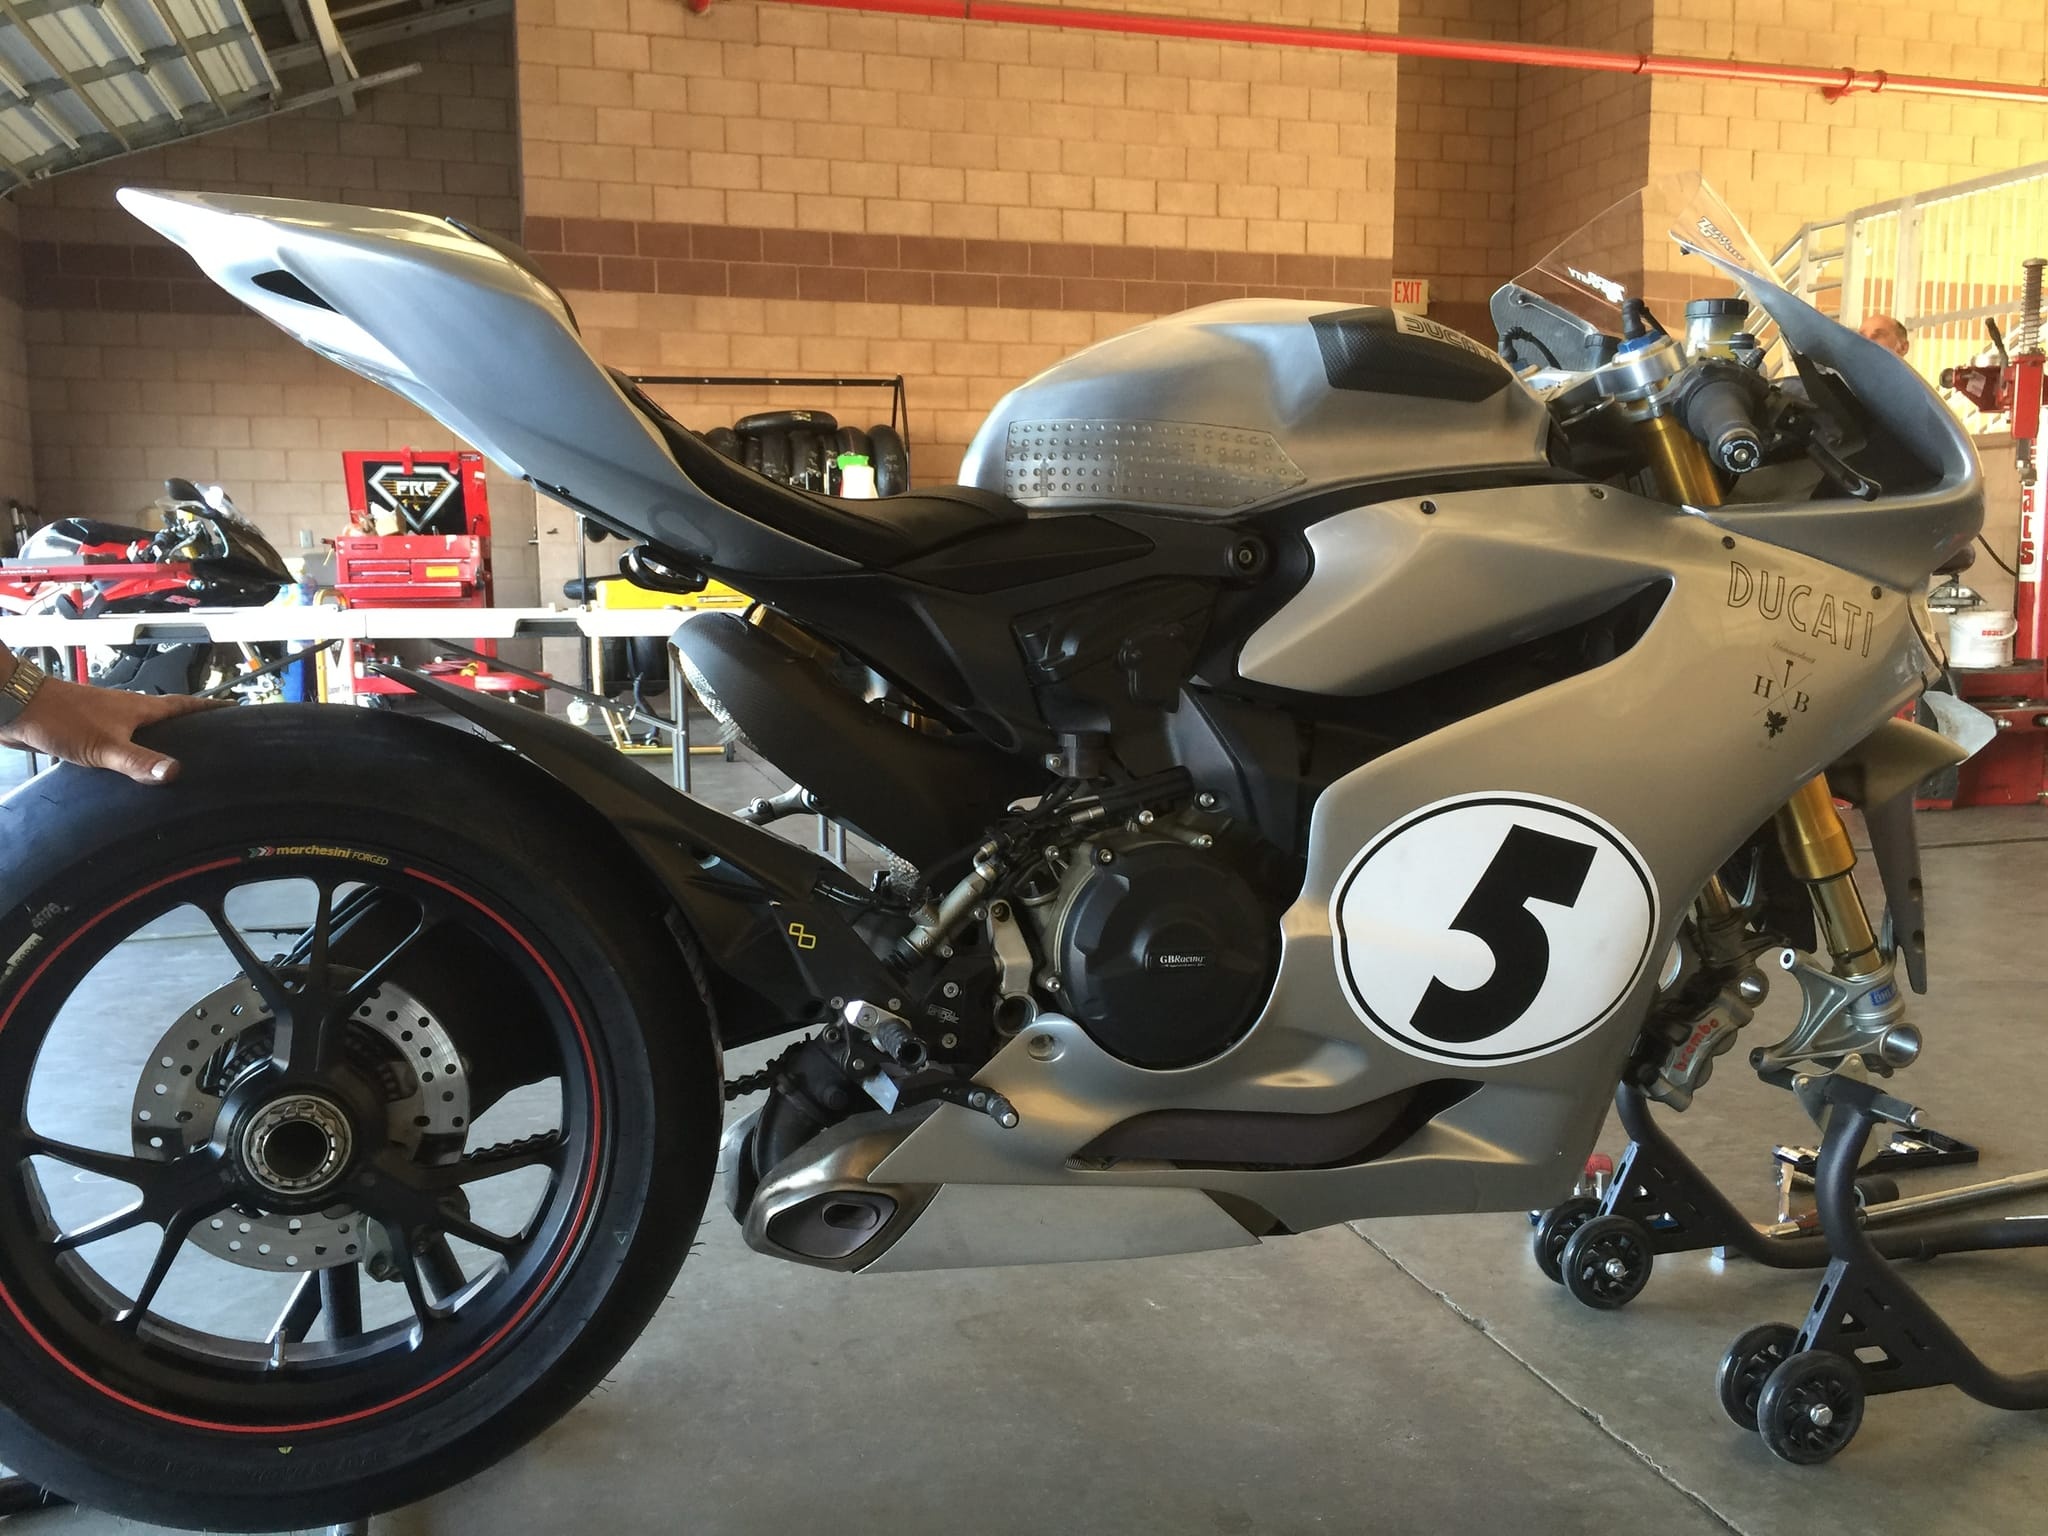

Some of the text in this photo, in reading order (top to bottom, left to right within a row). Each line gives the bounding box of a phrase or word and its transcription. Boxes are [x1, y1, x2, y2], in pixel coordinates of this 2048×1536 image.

[1394, 281, 1422, 304] EXIT
[1727, 560, 1873, 658] DUCATI
[1752, 674, 1810, 713] H B
[275, 844, 389, 866] marchesini FORGED
[1409, 824, 1598, 1043] 5
[1159, 954, 1204, 964] GBRacing
[1672, 1018, 1719, 1072] brembo
